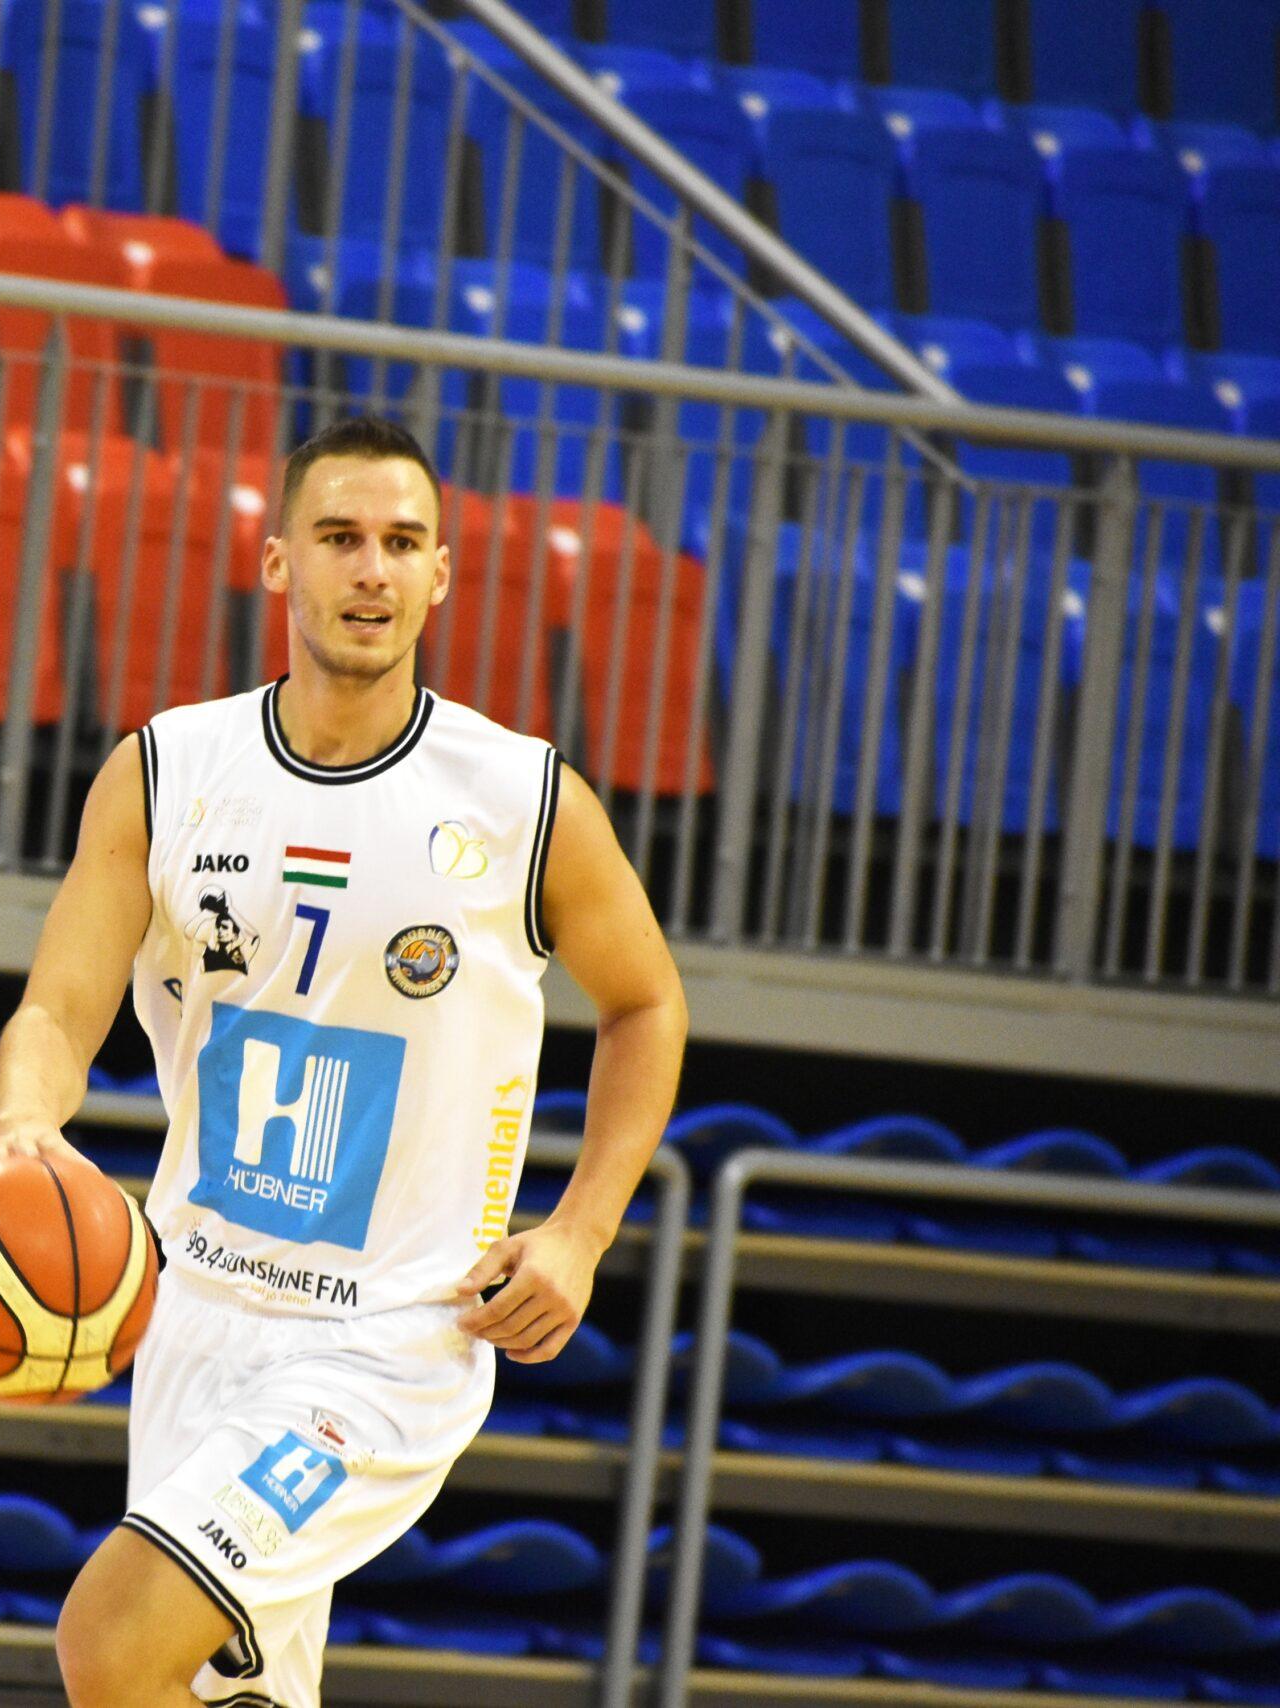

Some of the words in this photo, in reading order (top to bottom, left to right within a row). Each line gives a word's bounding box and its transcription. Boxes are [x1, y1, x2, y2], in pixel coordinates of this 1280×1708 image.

[192, 854, 249, 873] JAKO
[295, 903, 331, 997] 7
[223, 1165, 328, 1214] HÜBNER
[473, 1108, 524, 1250] tinental
[186, 1230, 223, 1268] 99.4
[219, 1252, 314, 1293] SUNSHINE
[316, 1275, 357, 1307] FM
[197, 1519, 247, 1570] JAKO
